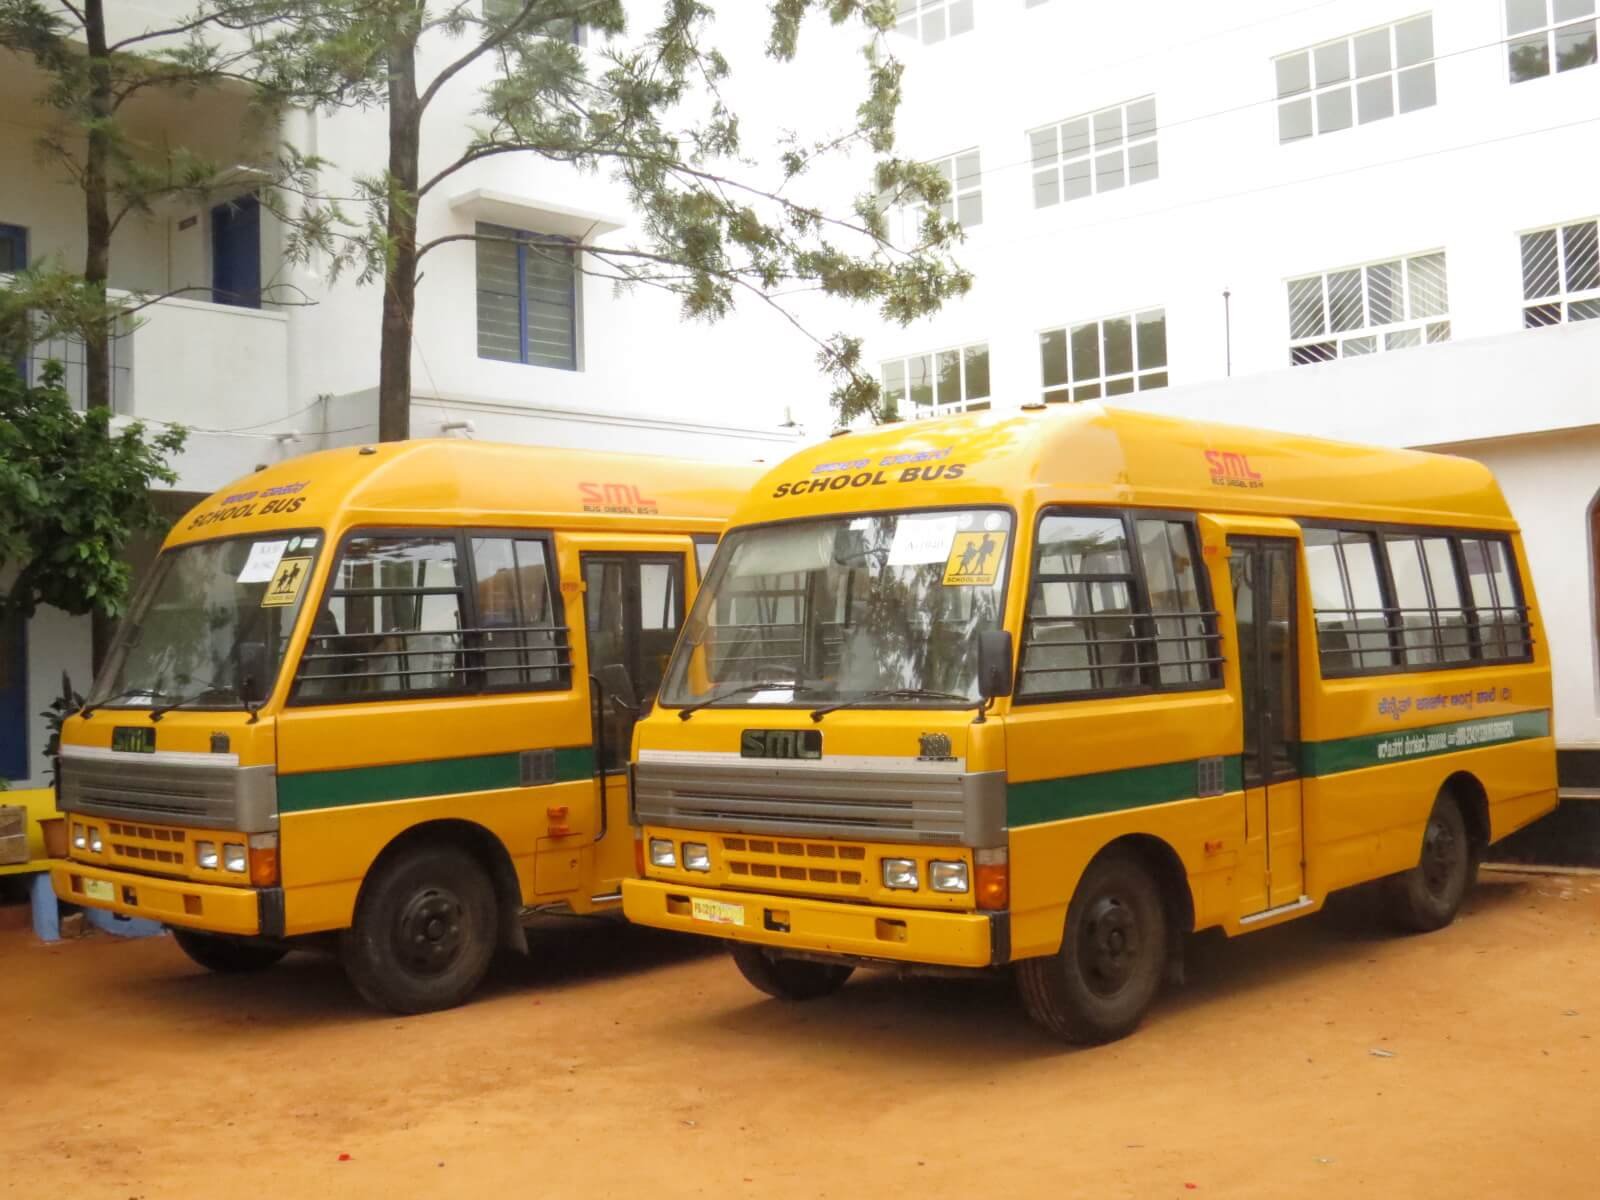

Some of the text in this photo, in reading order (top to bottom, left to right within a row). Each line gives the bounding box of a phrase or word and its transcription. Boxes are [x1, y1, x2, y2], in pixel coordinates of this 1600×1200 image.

[773, 463, 966, 498] SCHOOL BUS
[187, 496, 306, 530] SCHOOL BUS
[743, 731, 820, 758] SML
